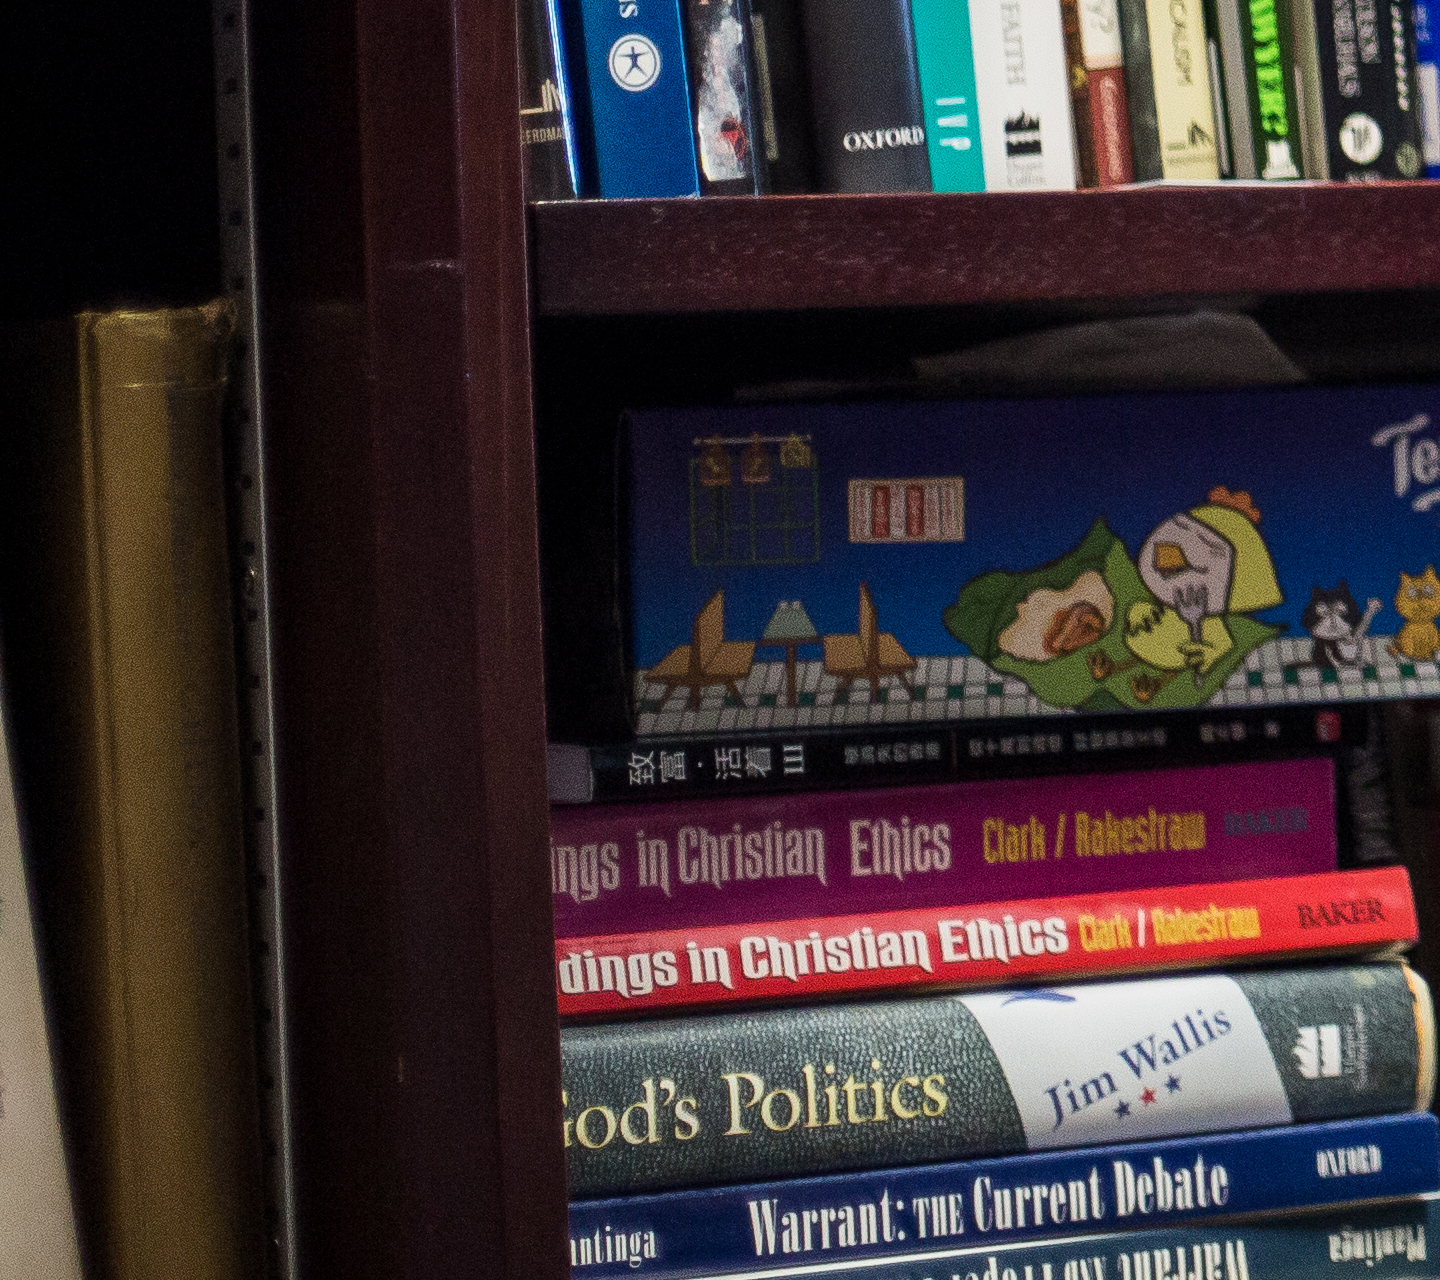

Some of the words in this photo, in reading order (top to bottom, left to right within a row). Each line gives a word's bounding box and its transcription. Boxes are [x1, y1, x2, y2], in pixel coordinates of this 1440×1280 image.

[1002, 2, 1027, 85] FAITH
[843, 126, 925, 152] OXFORD
[935, 95, 971, 151] IVP
[636, 831, 671, 898] in
[678, 820, 828, 889] Christian
[849, 815, 953, 881] Ethics
[981, 813, 1047, 863] Clark
[1075, 806, 1207, 857] Rakestraw
[687, 939, 734, 989] in
[740, 927, 933, 983] Christian
[938, 914, 1070, 965] Ethics
[1077, 913, 1134, 953] Clark
[1150, 905, 1262, 947] Rakestraw
[1297, 896, 1387, 929] BAKER
[721, 1058, 949, 1138] Politics
[1044, 1068, 1117, 1132] Jim
[1116, 1006, 1234, 1086] Wallis
[747, 1186, 907, 1258] Warrant:
[913, 1192, 965, 1239] THE
[974, 1165, 1106, 1233] Current
[1112, 1152, 1230, 1218] Debate
